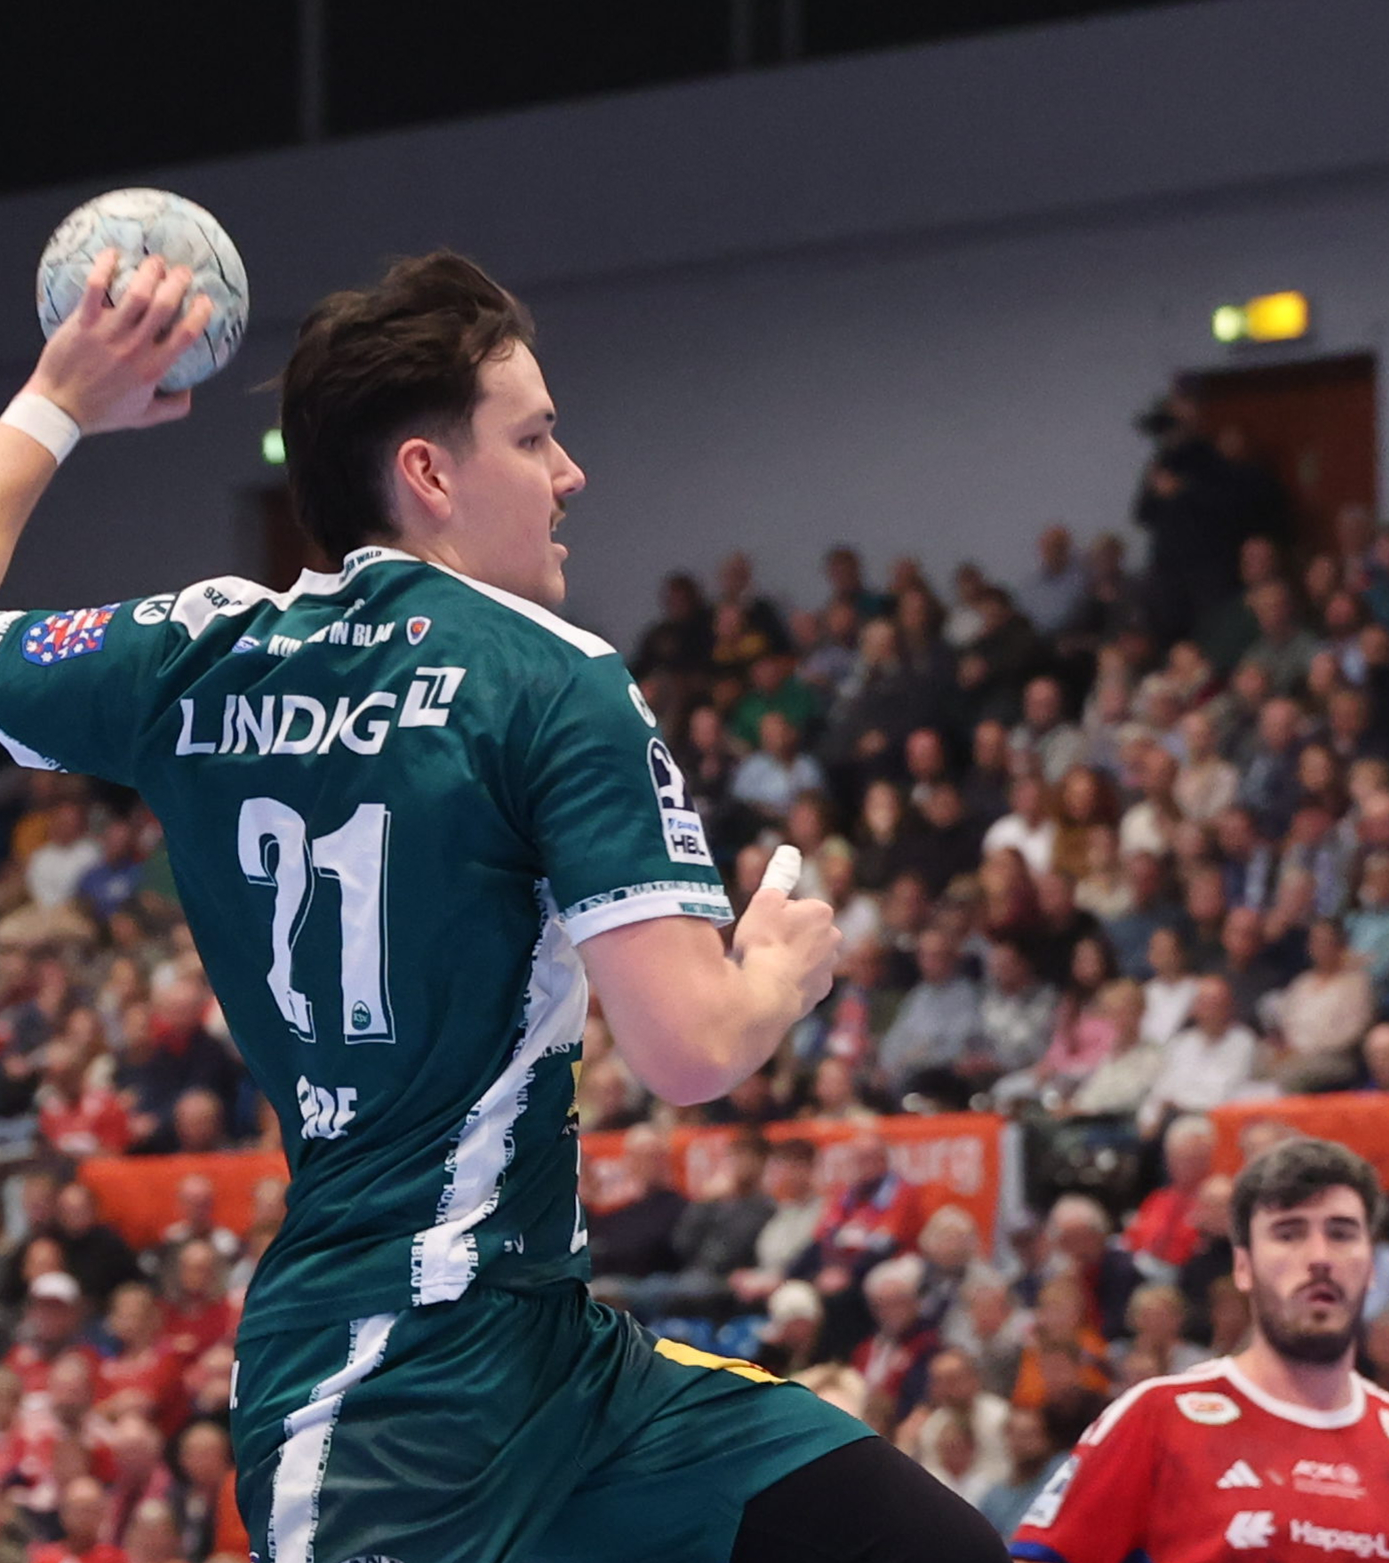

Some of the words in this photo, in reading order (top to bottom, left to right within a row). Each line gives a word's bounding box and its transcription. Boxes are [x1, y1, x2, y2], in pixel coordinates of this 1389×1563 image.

[329, 621, 349, 644] IN
[175, 691, 398, 755] LINDIG
[237, 797, 396, 1045] 21
[411, 1246, 423, 1288] BLAU
